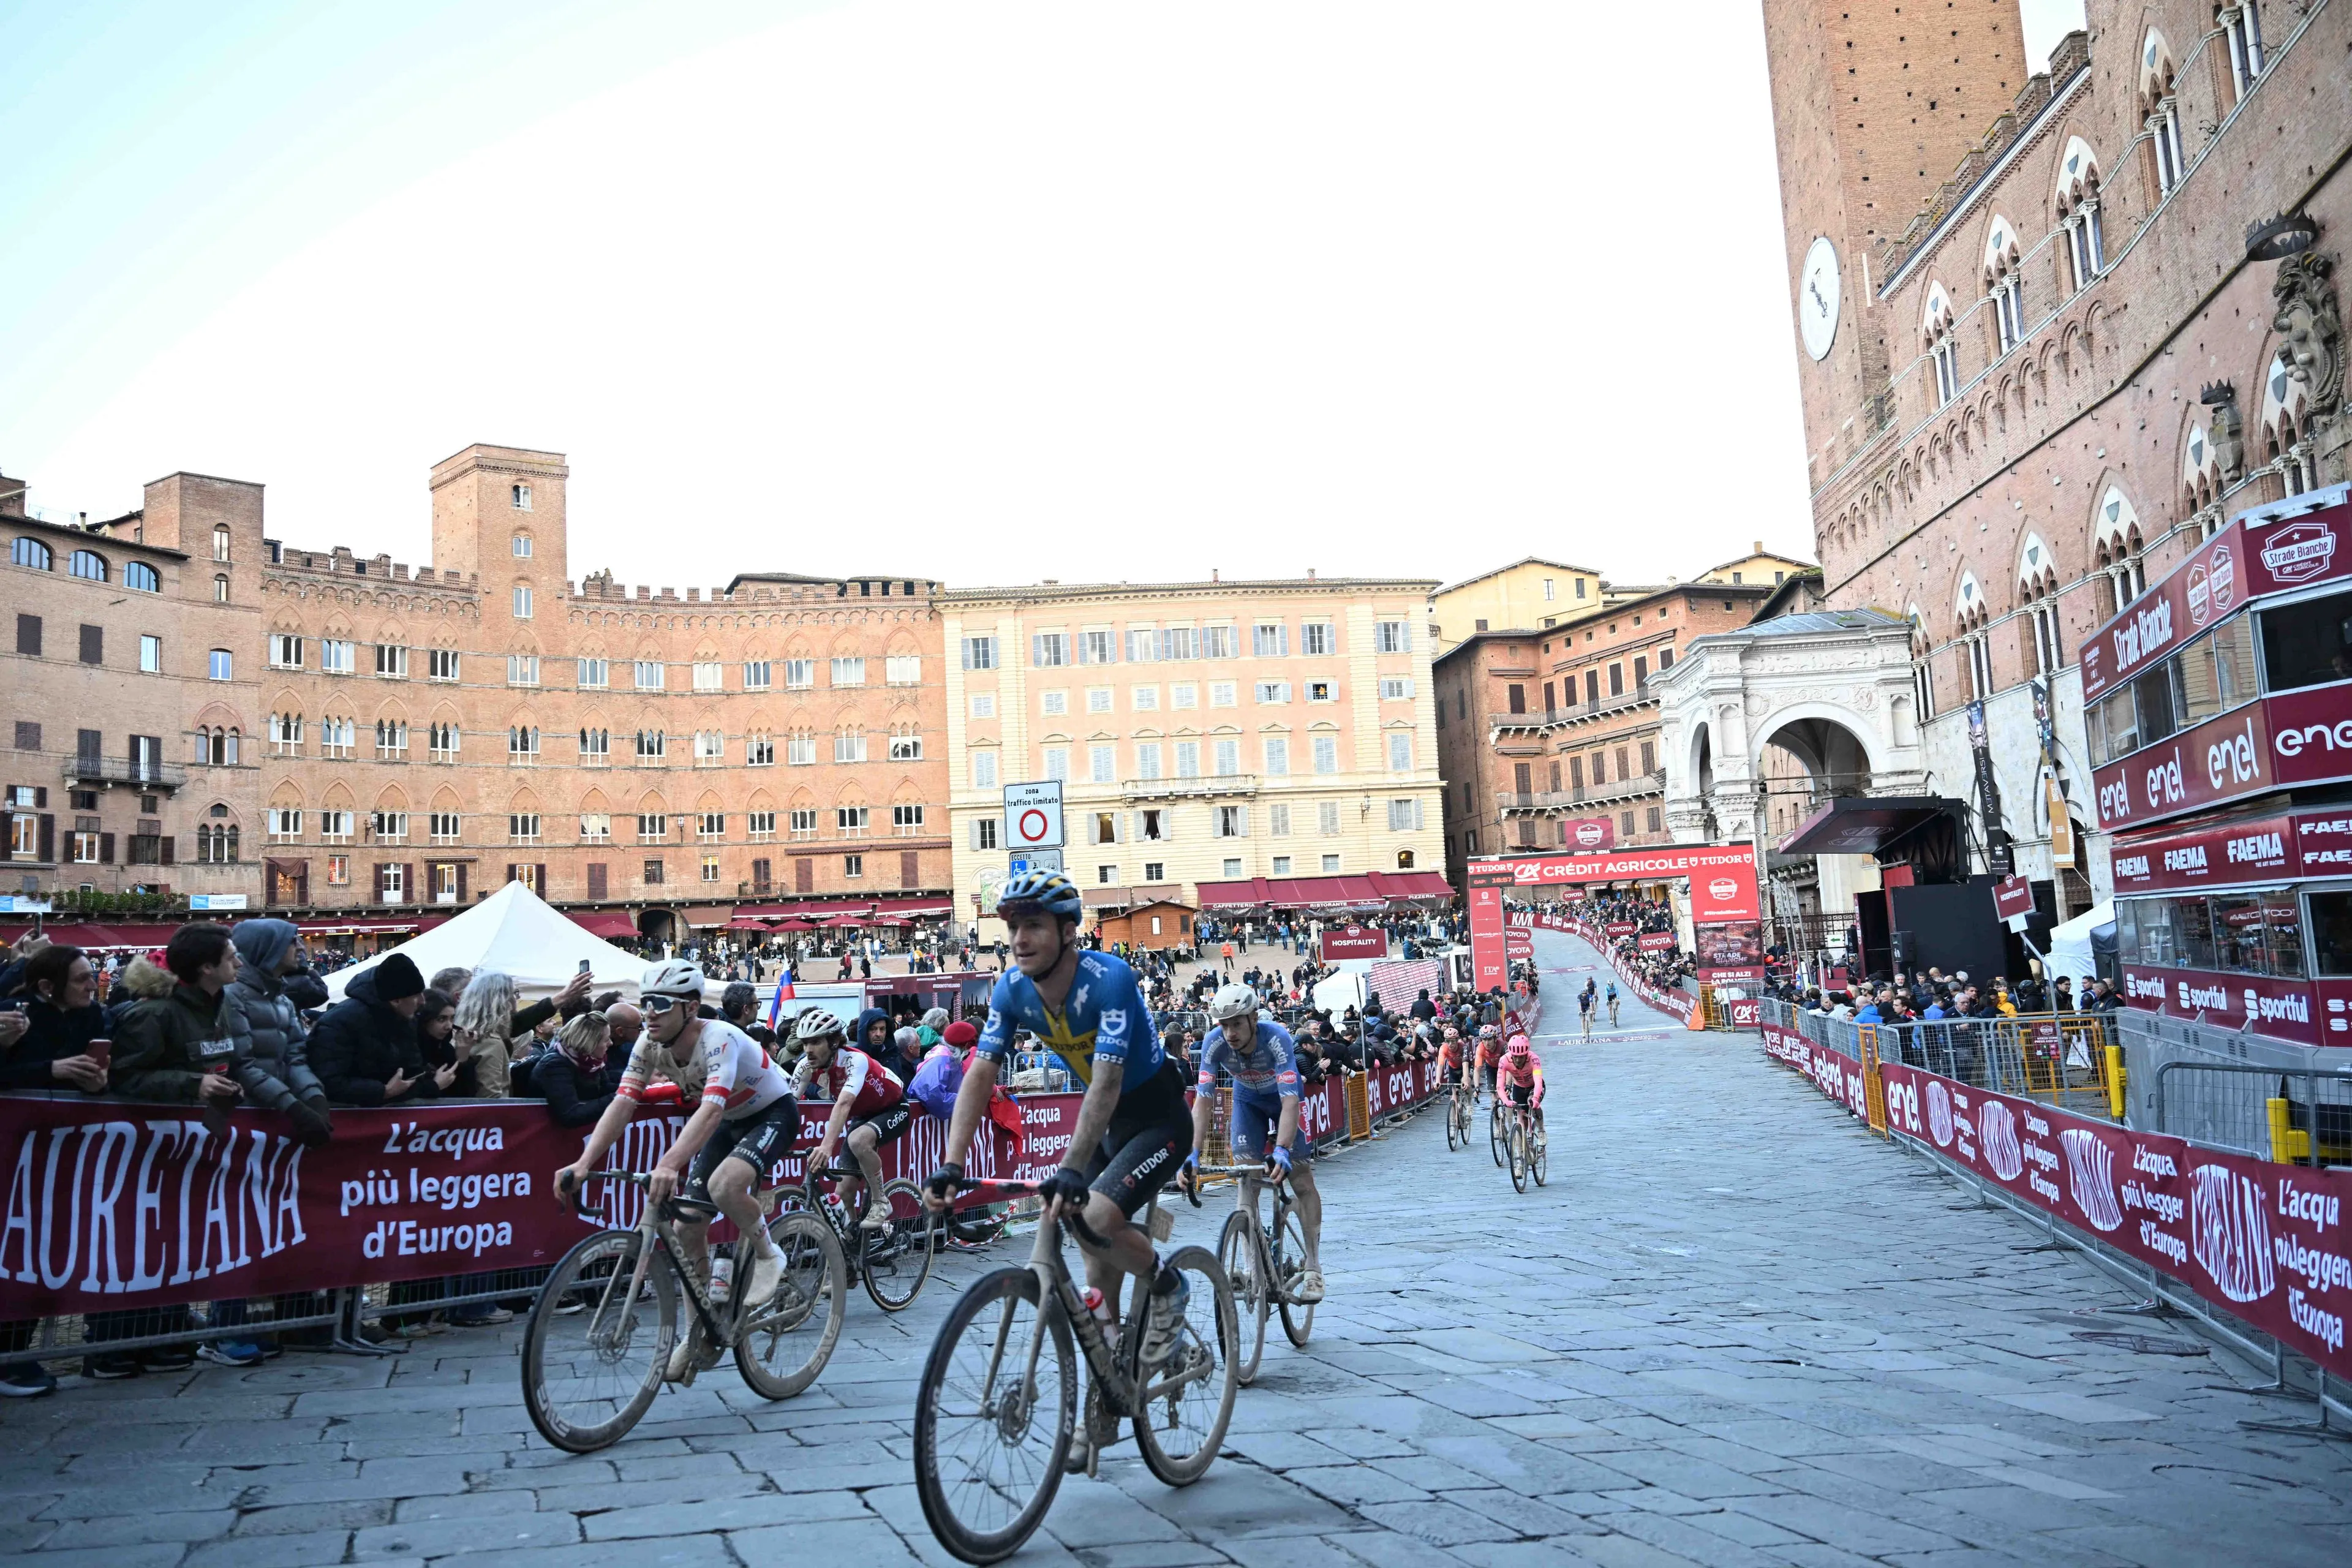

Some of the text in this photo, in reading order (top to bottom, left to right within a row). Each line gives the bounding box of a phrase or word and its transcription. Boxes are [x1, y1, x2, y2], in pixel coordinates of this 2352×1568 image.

[2269, 541, 2328, 564] Strade Bianche
[2294, 562, 2319, 571] AGRICOLE
[2113, 595, 2173, 673] Strade Bianche
[2208, 717, 2259, 790] enel
[2275, 719, 2352, 757] ene
[2147, 747, 2185, 808] enel
[1007, 799, 1031, 807] traffico
[2100, 769, 2130, 821] enel
[2299, 819, 2352, 835] FAE
[2165, 845, 2207, 872] FAEMA
[2228, 832, 2284, 864] FAEMA
[2303, 850, 2352, 864] FAE
[1544, 862, 1602, 877] CRÉDIT
[1605, 858, 1688, 873] AGRICOLE
[1700, 855, 1742, 865] TUDOR
[2116, 855, 2150, 877] FAEMA
[2000, 888, 2024, 901] HOSPITALITY
[1641, 937, 1672, 946] TOYOTA
[1080, 956, 1109, 978] BMC
[2136, 977, 2165, 999] sportful
[2190, 986, 2228, 1011] sportful
[2260, 995, 2309, 1023] sportful
[200, 1038, 233, 1055] NORWAY
[1267, 1035, 1288, 1066] Alpecin
[1558, 1036, 1611, 1046] LAURETANA
[865, 1073, 885, 1097] Cofidis
[1368, 1069, 1381, 1115] enel
[1389, 1061, 1414, 1105] enel
[1847, 1068, 1866, 1118] enel
[887, 1109, 908, 1129] Cofidis
[1888, 1073, 1923, 1134] enel
[2023, 1109, 2049, 1140] L'acqua
[383, 1123, 503, 1160] L'acqua
[897, 1114, 997, 1198] LAURANA
[1029, 1133, 1072, 1157] leggera
[1014, 1163, 1060, 1181] d'Europ
[1131, 1148, 1170, 1180] TUDOR
[2133, 1144, 2178, 1182] L'acqua
[340, 1167, 531, 1216] più leggera
[888, 1186, 923, 1207] CORIMA
[2030, 1168, 2060, 1205] d'Europa
[2121, 1178, 2184, 1224] più legger
[0, 1120, 306, 1294] AURETANA
[364, 1221, 513, 1259] d'Europa
[2139, 1218, 2187, 1267] d'Europa
[1063, 1355, 1076, 1404] SWISS
